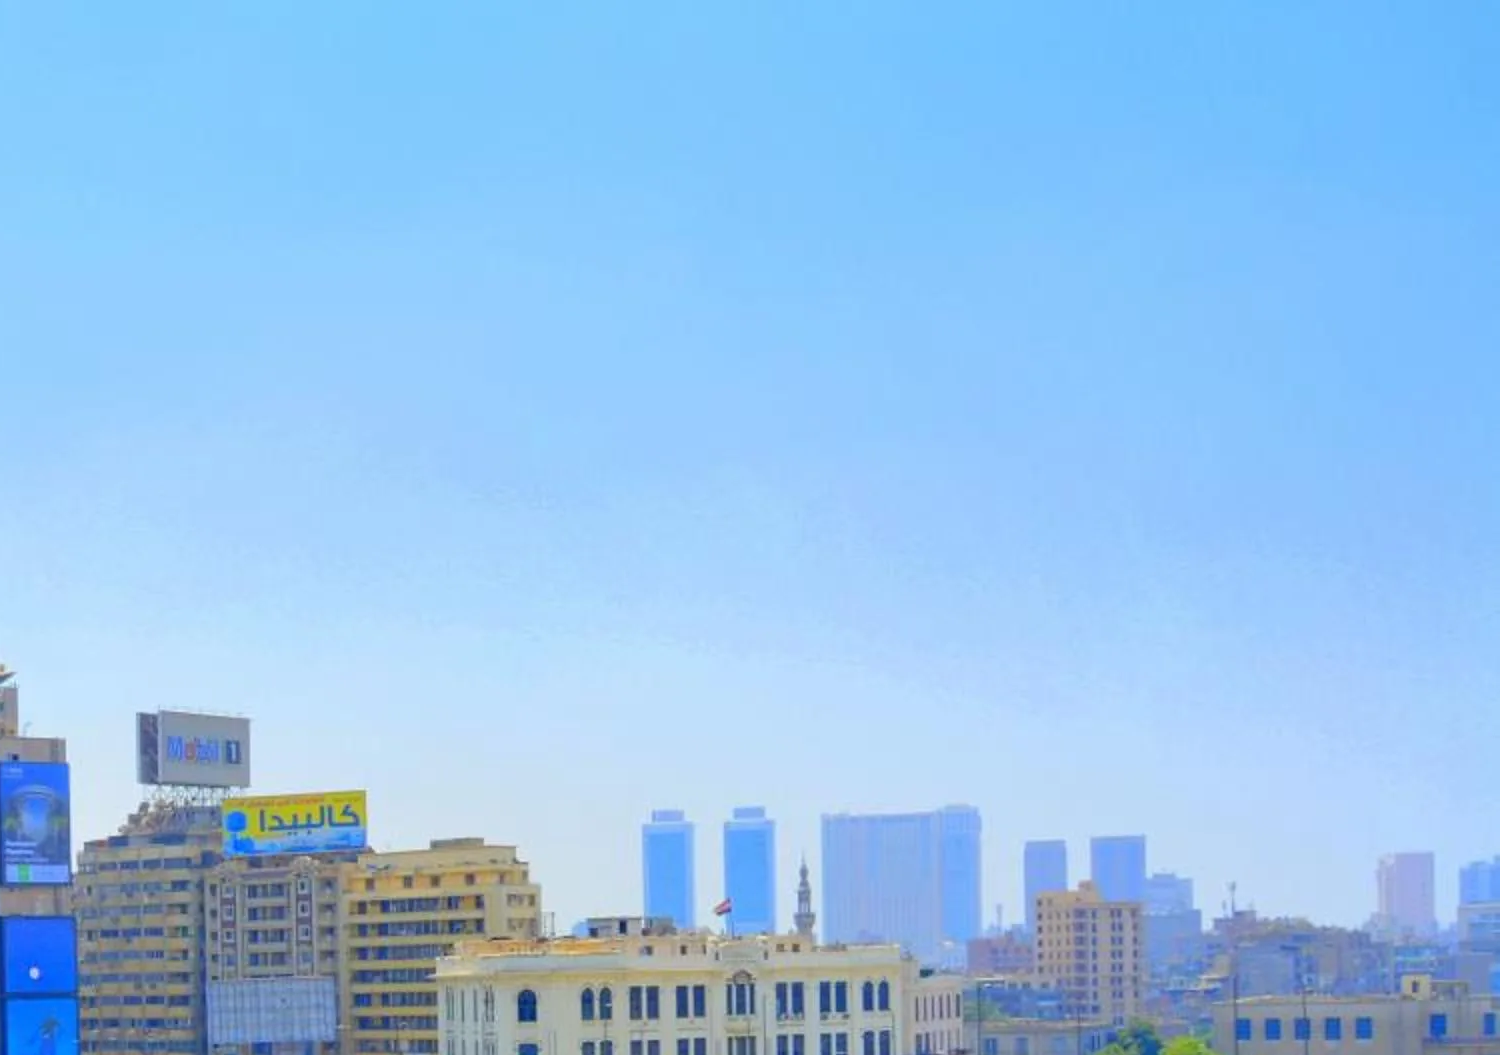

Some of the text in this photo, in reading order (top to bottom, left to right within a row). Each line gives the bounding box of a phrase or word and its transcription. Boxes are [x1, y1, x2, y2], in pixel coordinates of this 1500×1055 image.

[167, 736, 241, 764] Mobil 1
[259, 804, 360, 836] كالبيدا
